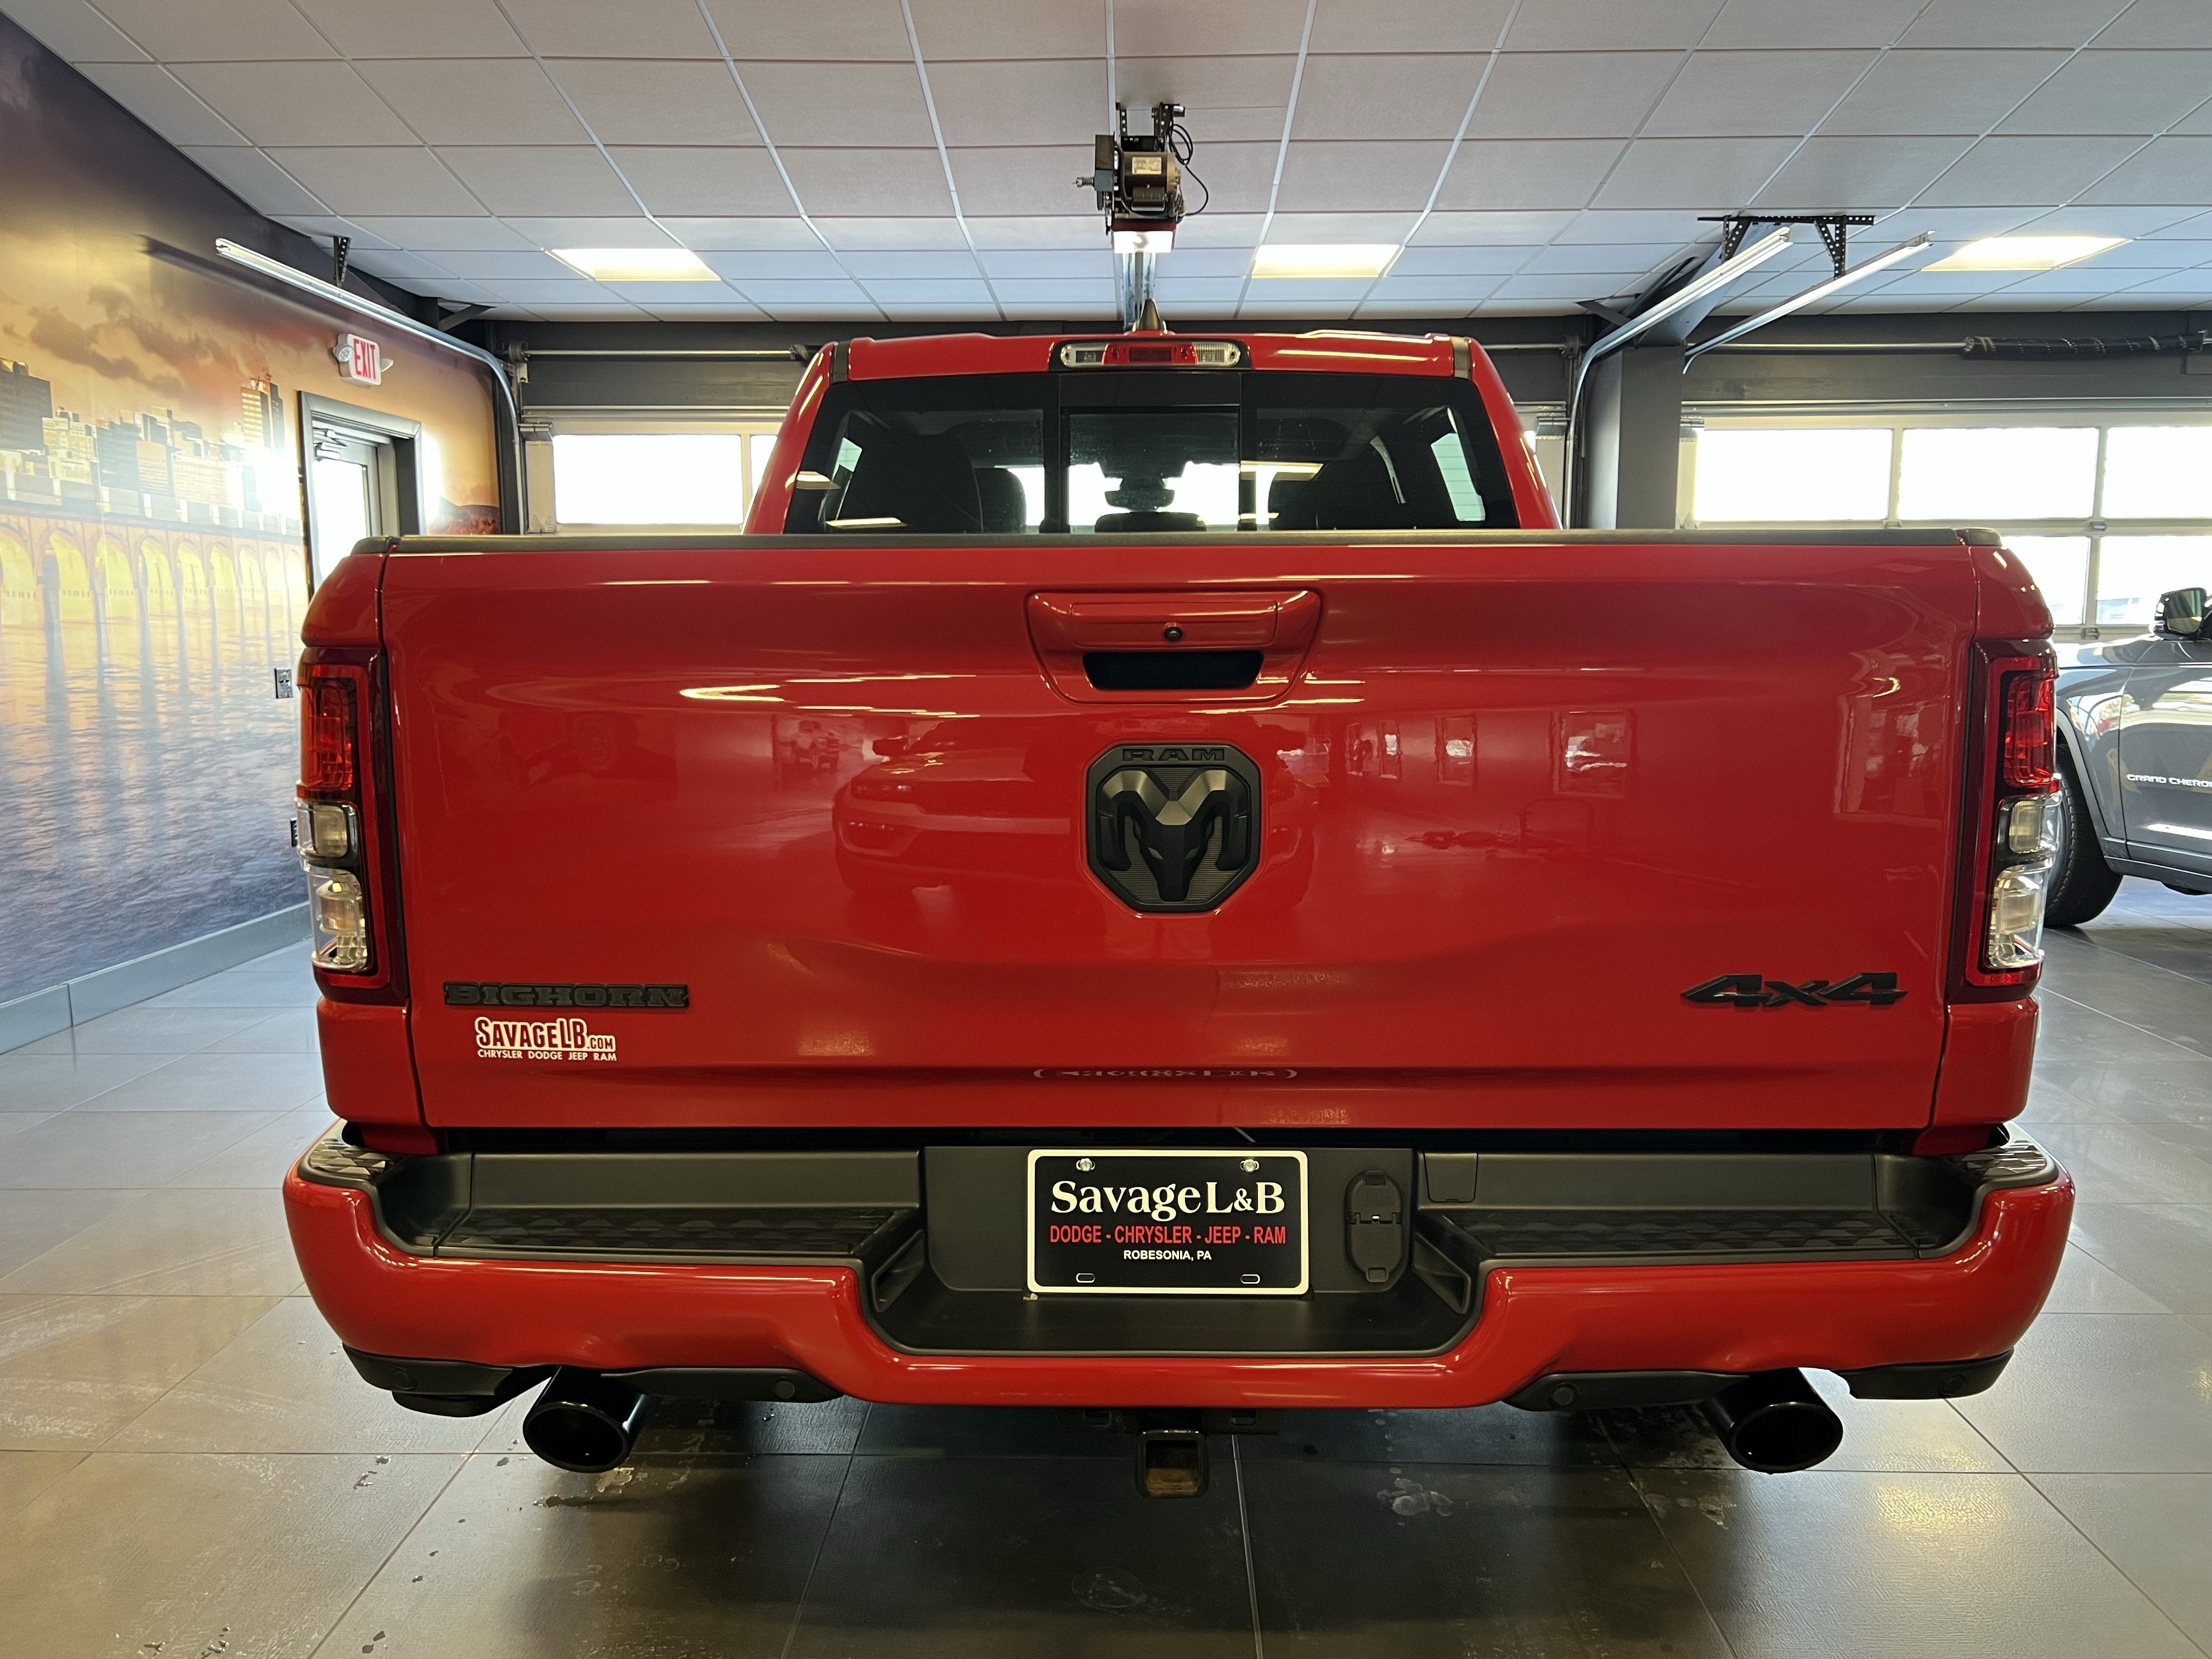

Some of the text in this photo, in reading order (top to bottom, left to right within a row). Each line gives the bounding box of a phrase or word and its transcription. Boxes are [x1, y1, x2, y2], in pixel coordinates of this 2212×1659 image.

[353, 338, 376, 380] EXIT
[1122, 749, 1224, 761] RAM
[2126, 774, 2167, 784] GRAND
[444, 983, 689, 1007] BIGHORN
[477, 1049, 617, 1061] CHRYSLER DODGE JEEP RAM
[1051, 1181, 1285, 1221] Savage L&B
[1049, 1225, 1102, 1243] DODGE
[1114, 1226, 1192, 1244] CHRYSLER
[1204, 1226, 1241, 1244] JEEP
[1254, 1226, 1286, 1244] RAM
[1123, 1250, 1212, 1261] ROBESONIA, PA
